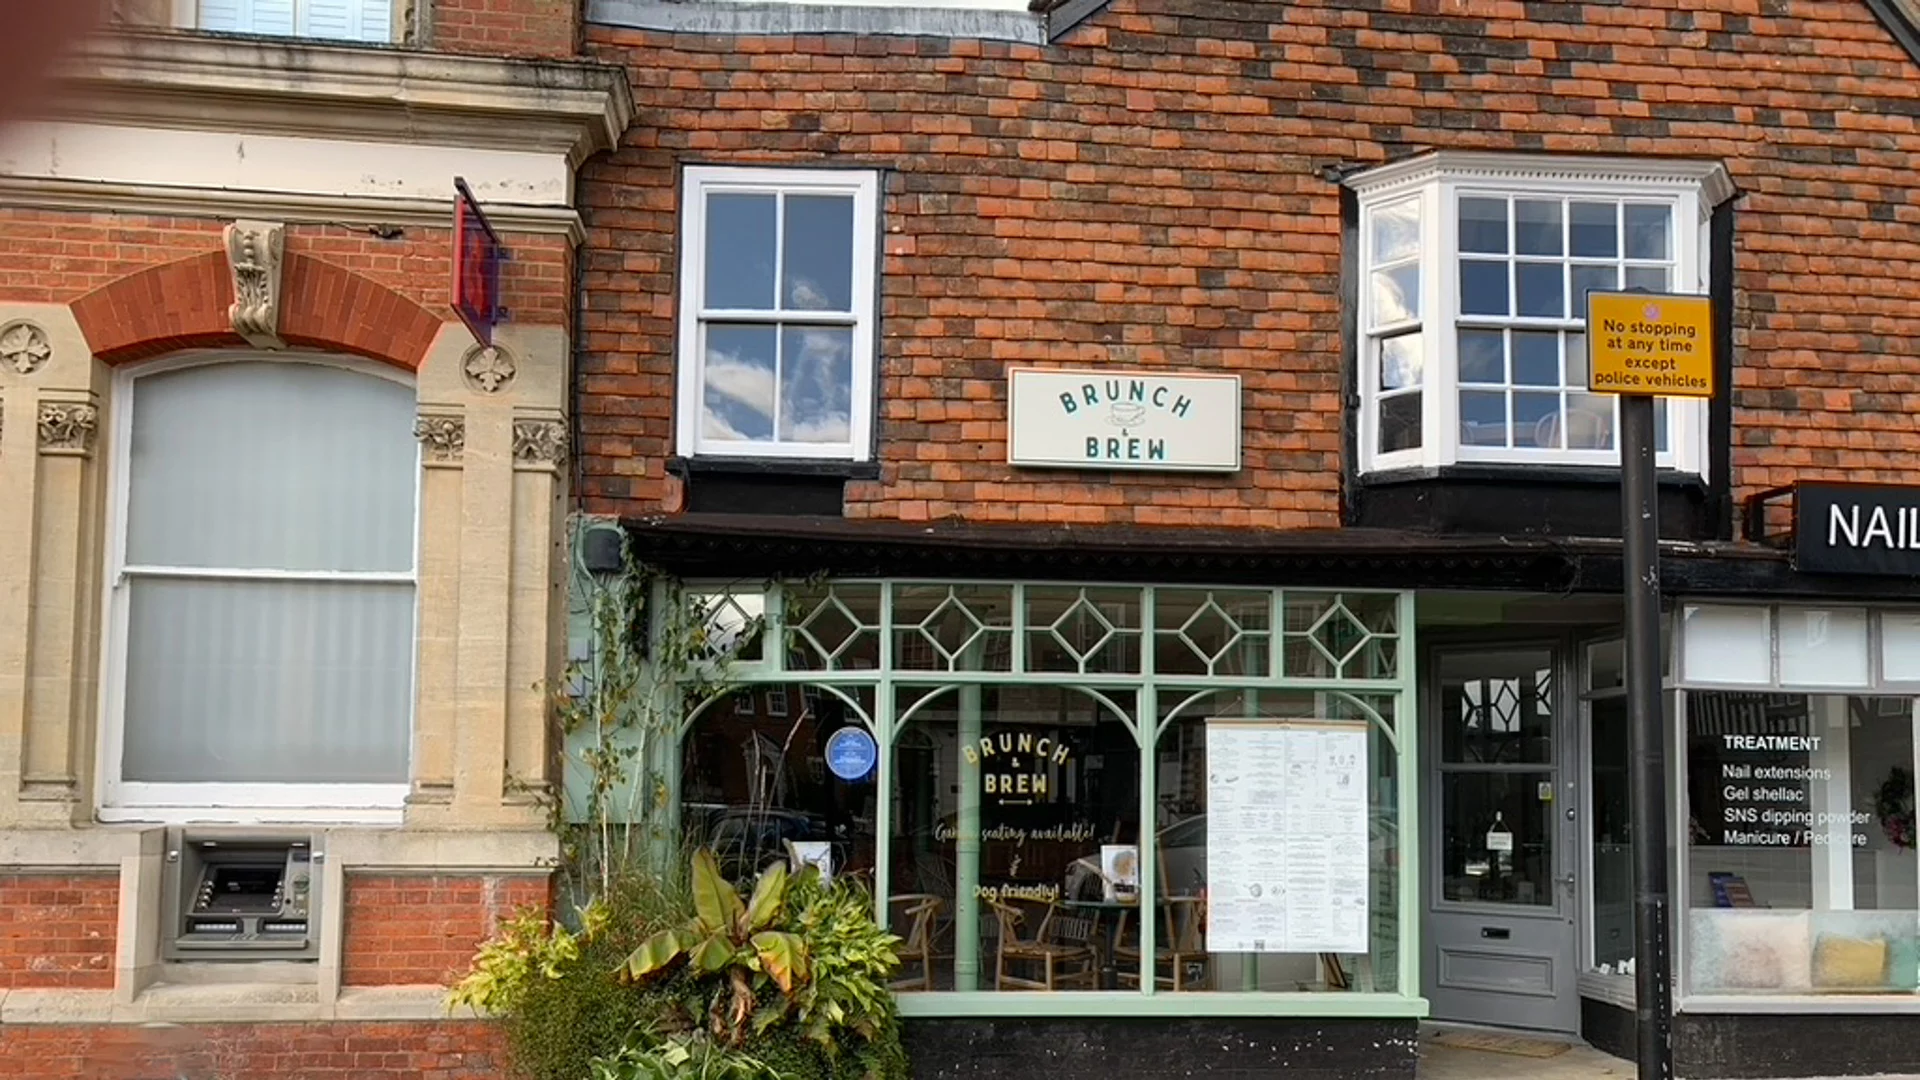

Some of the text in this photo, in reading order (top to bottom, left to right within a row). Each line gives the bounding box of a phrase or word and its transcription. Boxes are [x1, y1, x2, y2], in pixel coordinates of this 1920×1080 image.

[1603, 319, 1696, 338] No stopping
[1607, 337, 1693, 352] at any time
[1625, 357, 1676, 371] except
[1595, 372, 1707, 388] police vehicles
[1059, 380, 1192, 418] BRUNCH
[1086, 436, 1164, 460] BREW
[962, 732, 1070, 765] BRUNCH
[1723, 735, 1821, 751] TREATMENT
[1011, 757, 1020, 768] &
[1722, 765, 1831, 780] Nail extensions
[984, 773, 1048, 794] BREW
[1723, 786, 1804, 802] Gel shellac
[1723, 808, 1870, 826] SNS dipping powder
[982, 822, 1027, 848] seating
[1030, 822, 1095, 843] available!
[1723, 830, 1867, 846] Manicure / Pedcre
[973, 883, 1059, 902] Dog friendly!
